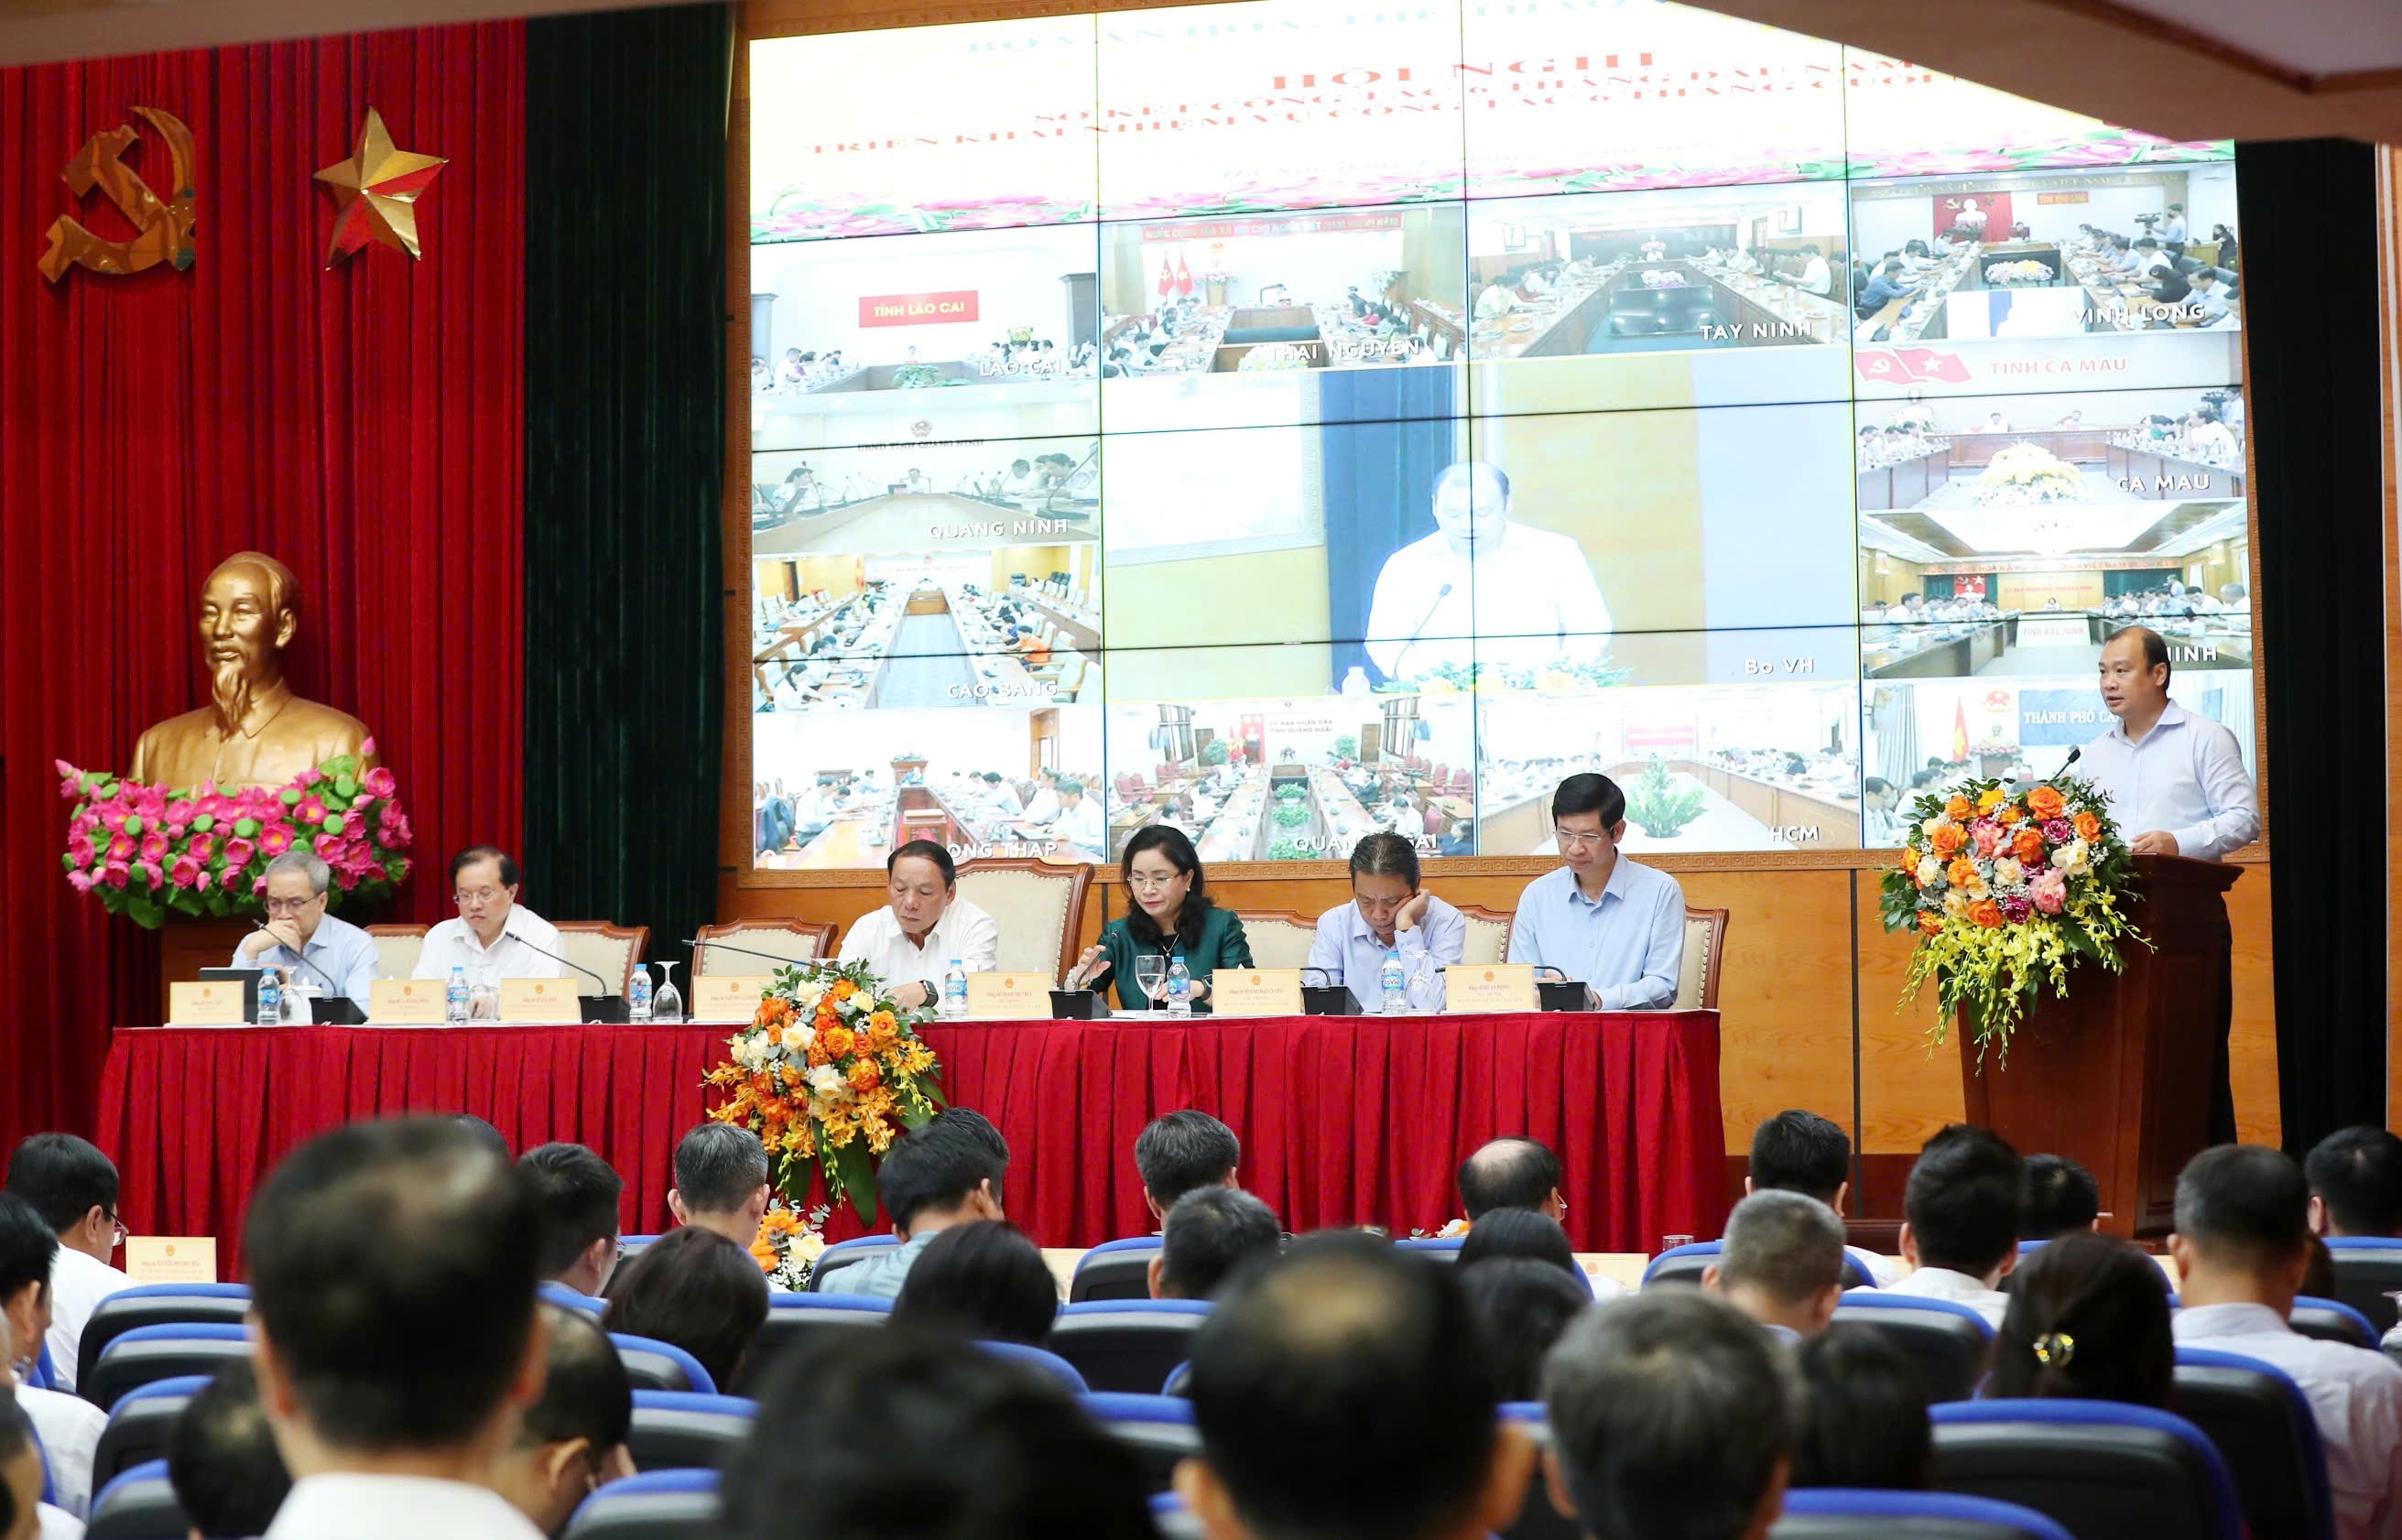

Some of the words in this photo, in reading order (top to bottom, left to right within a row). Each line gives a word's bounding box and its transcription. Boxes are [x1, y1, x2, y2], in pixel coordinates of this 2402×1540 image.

[939, 300, 965, 313] CAI
[2073, 307, 2132, 325] VINH
[2140, 304, 2206, 322] LONG
[1700, 324, 1743, 341] TAY
[1752, 321, 1812, 338] NINH
[1329, 340, 1421, 358] NGUYEN
[979, 361, 1021, 377] LAO
[1029, 359, 1062, 375] CAI
[2116, 476, 2145, 493] CA
[2154, 474, 2211, 491] MAU
[929, 521, 1005, 540] QUANG
[1012, 518, 1069, 536] NINH
[1744, 658, 1774, 675] Bo
[1782, 657, 1815, 673] VH
[947, 683, 991, 700] CAO
[2023, 708, 2067, 724] THÀNH
[1768, 825, 1819, 842] HCM
[1003, 840, 1059, 858] THAP
